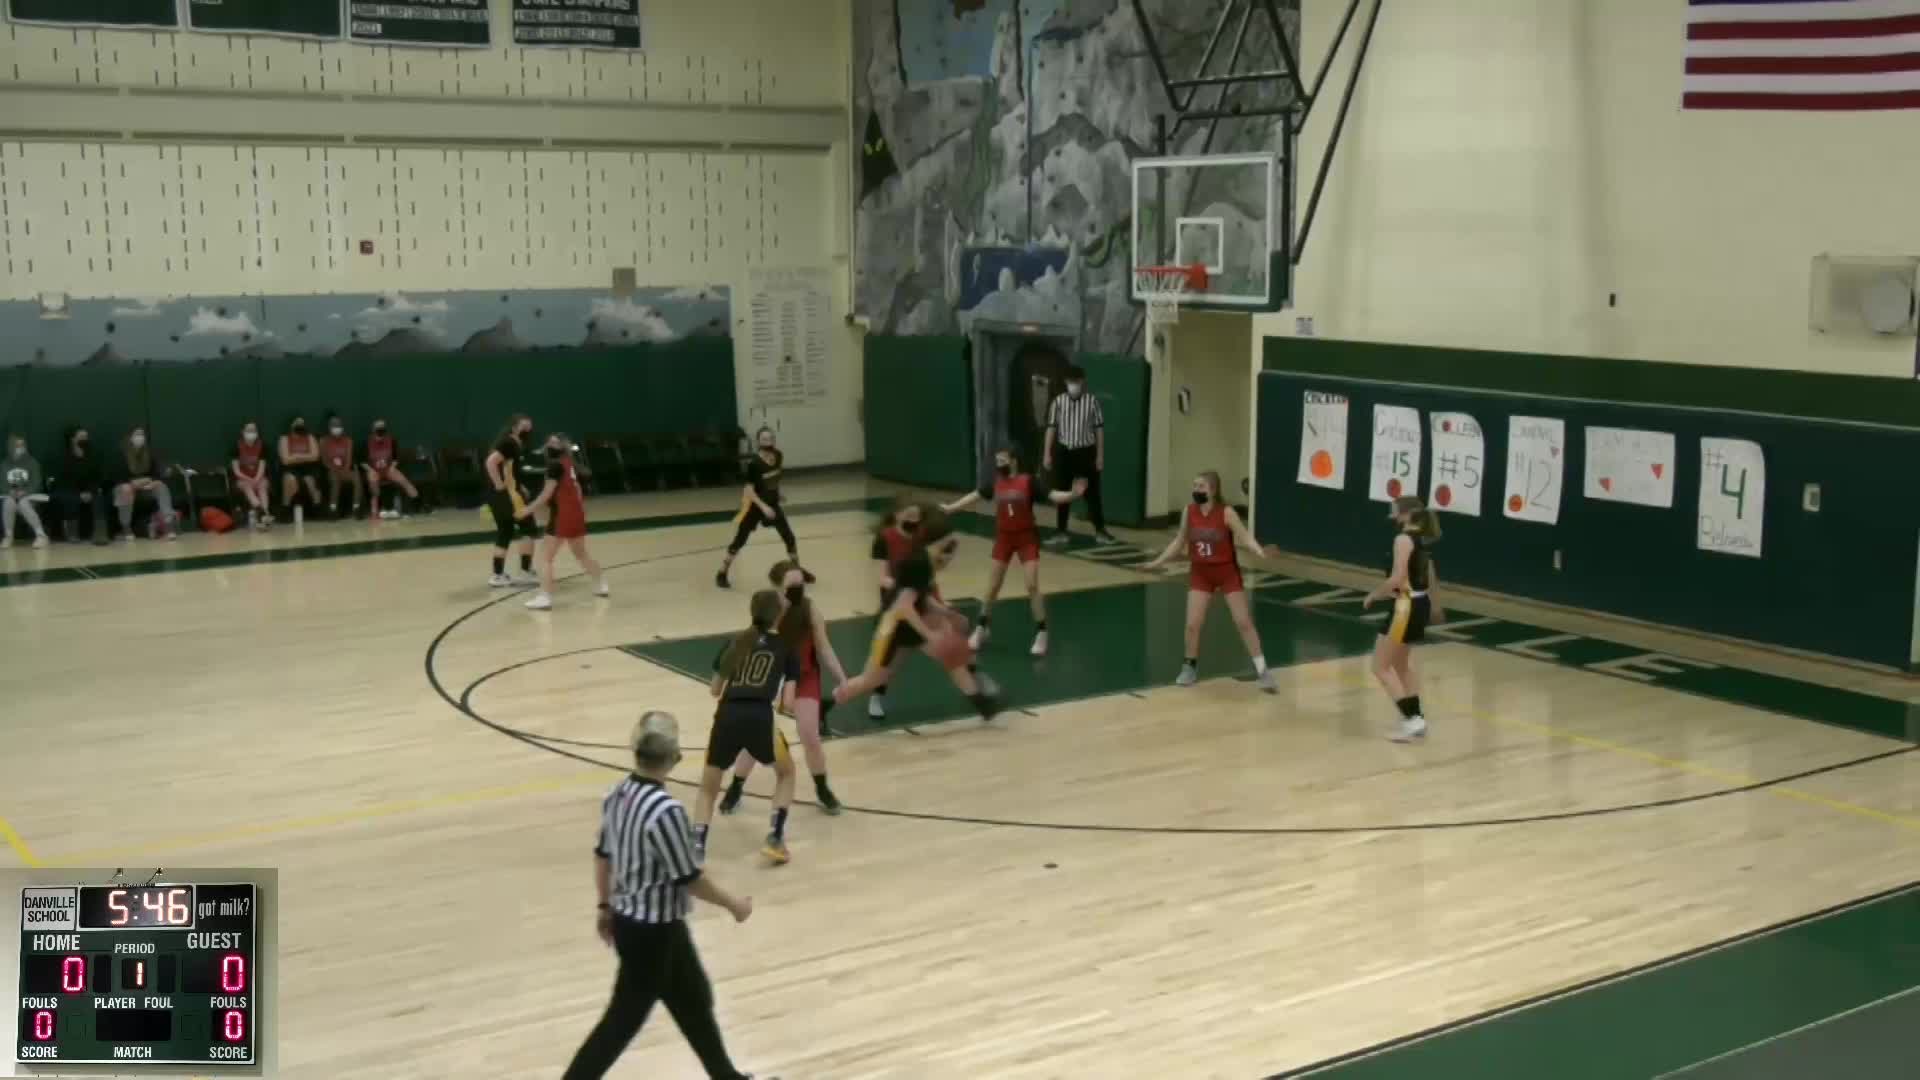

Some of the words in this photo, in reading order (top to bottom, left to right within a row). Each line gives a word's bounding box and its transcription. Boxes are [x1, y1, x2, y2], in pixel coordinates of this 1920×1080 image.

[1438, 448, 1480, 489] #5
[1194, 541, 1212, 557] 21
[731, 650, 775, 687] 10
